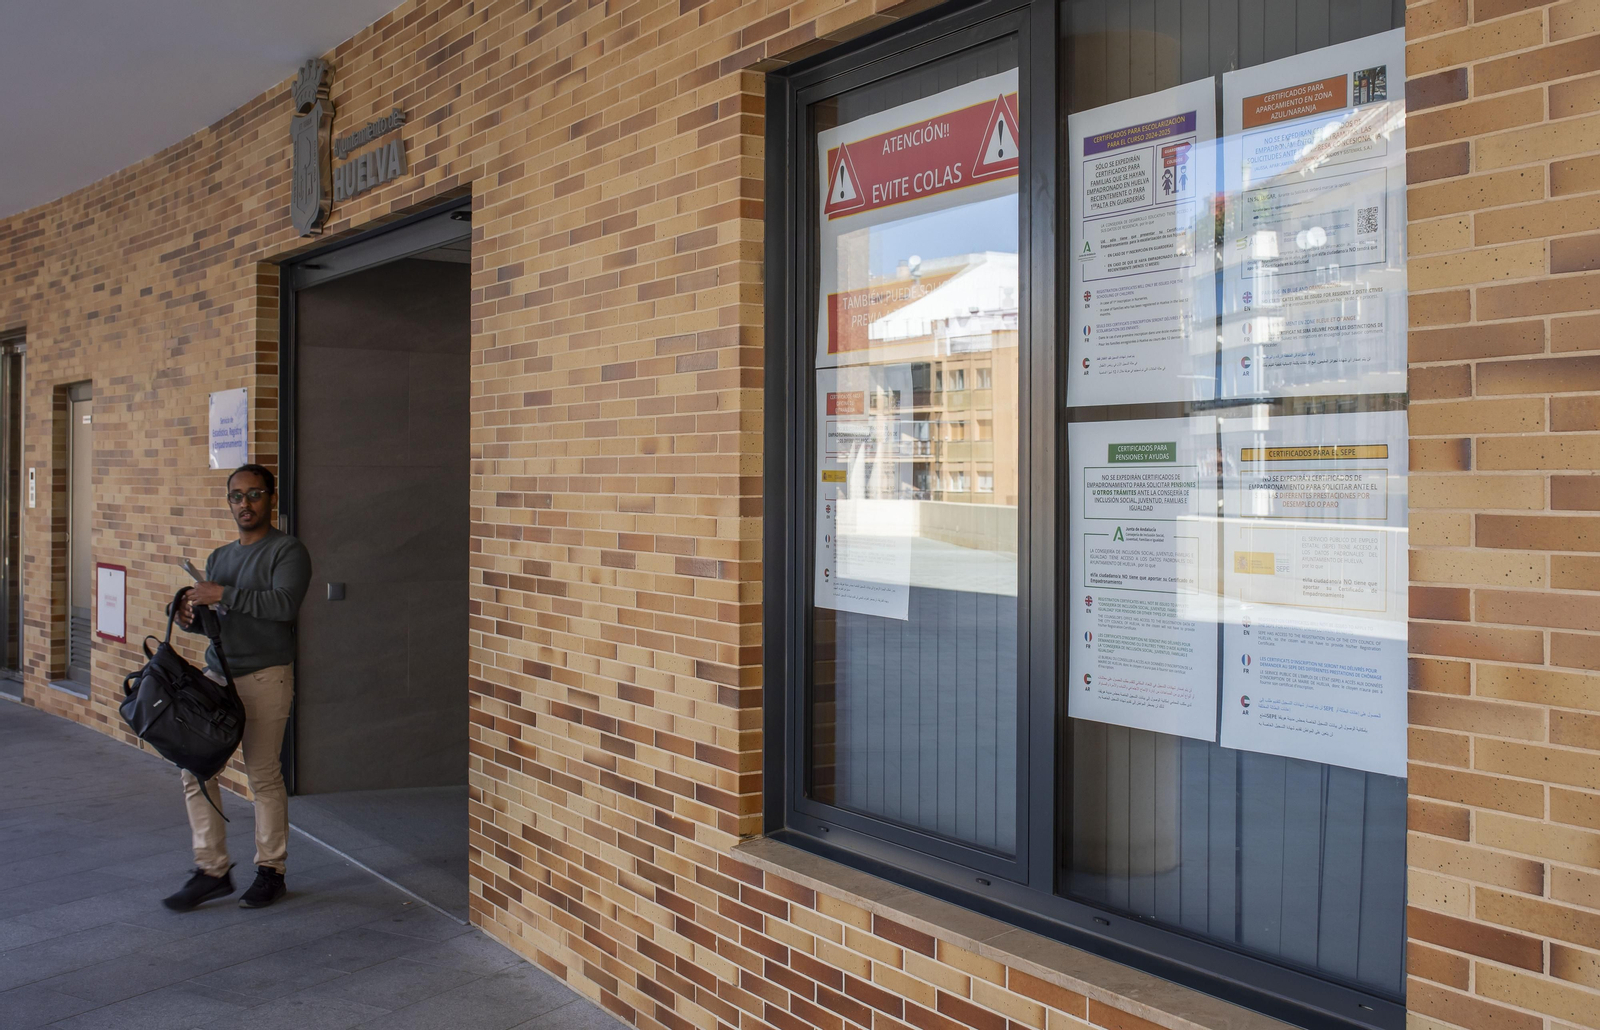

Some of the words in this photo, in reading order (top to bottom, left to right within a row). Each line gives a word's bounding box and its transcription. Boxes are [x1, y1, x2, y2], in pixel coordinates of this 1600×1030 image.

[1264, 88, 1306, 103] CERTIFICADOS
[1307, 83, 1324, 94] PARA
[1256, 97, 1303, 114] APARCAMIENTO
[1304, 95, 1312, 104] EN
[1314, 91, 1332, 102] ZONA
[1271, 104, 1316, 121] AZUL/NARANJA
[1094, 130, 1126, 144] CERTIFICADOS
[1128, 127, 1141, 136] PARA
[1142, 116, 1185, 132] ESCOLARIZACIÓN
[1107, 140, 1119, 148] PARA
[1127, 134, 1144, 144] CURSO
[1146, 128, 1170, 140] 2024-2025
[1282, 128, 1311, 141] EXPEDIRÁN
[1361, 126, 1372, 134] LAS
[882, 123, 950, 155] ATENCIÓN!!
[1115, 155, 1140, 166] EXPEDIRÁN
[1247, 152, 1281, 164] SOLICITUDES
[334, 139, 408, 202] HUELVA
[1091, 177, 1111, 187] FAMILIAS
[1129, 170, 1145, 179] HAYAN
[1096, 166, 1127, 178] CERTIFICADOS
[872, 176, 908, 204] EVITE
[913, 163, 962, 194] COLAS
[1087, 183, 1122, 196] EMPADRONADO
[1131, 177, 1149, 186] HUELVA
[1091, 190, 1127, 202] RECIENTEMENTE
[1117, 194, 1145, 205] GUARDERÍAS
[842, 289, 884, 310] TAMBIÉN
[885, 287, 917, 303] PUEDE
[1303, 591, 1344, 599] Empadronamiento
